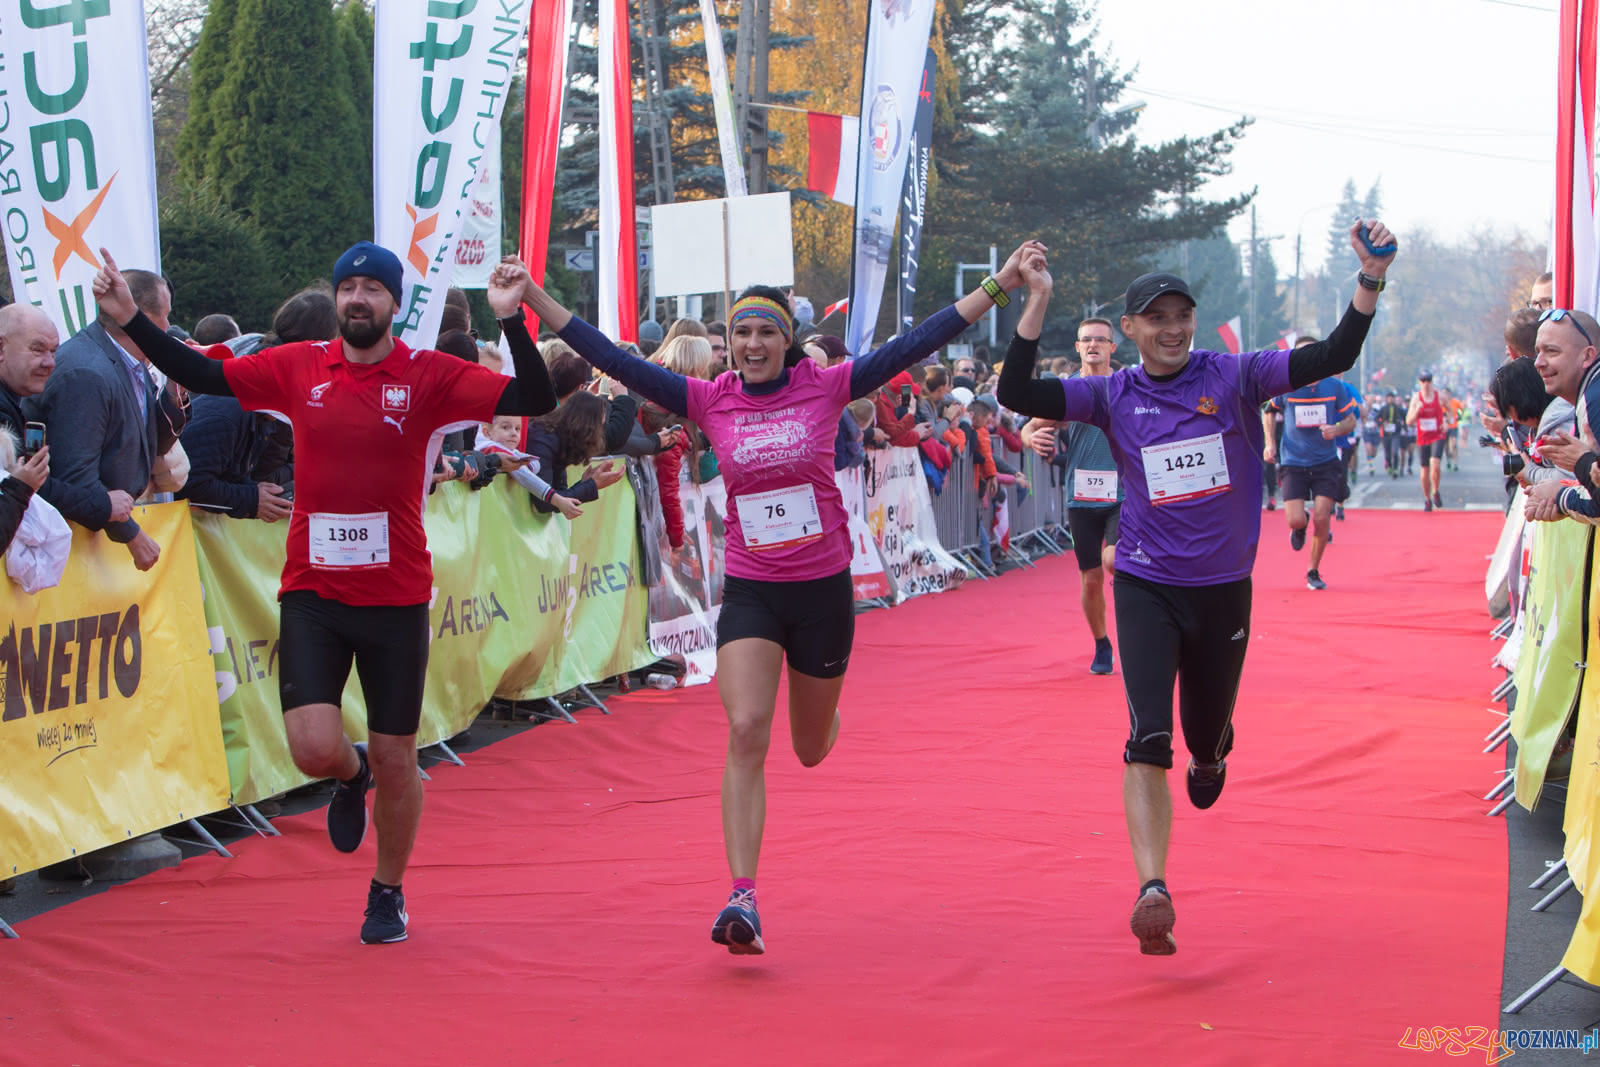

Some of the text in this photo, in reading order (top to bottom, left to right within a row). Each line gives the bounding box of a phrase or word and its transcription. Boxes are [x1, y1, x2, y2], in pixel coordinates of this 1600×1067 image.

[1164, 452, 1206, 472] 1422
[1087, 477, 1104, 486] 575
[764, 503, 786, 519] 76
[328, 527, 369, 542] 1308
[20, 603, 142, 715] NETTO
[37, 716, 98, 752] więcej za mniej
